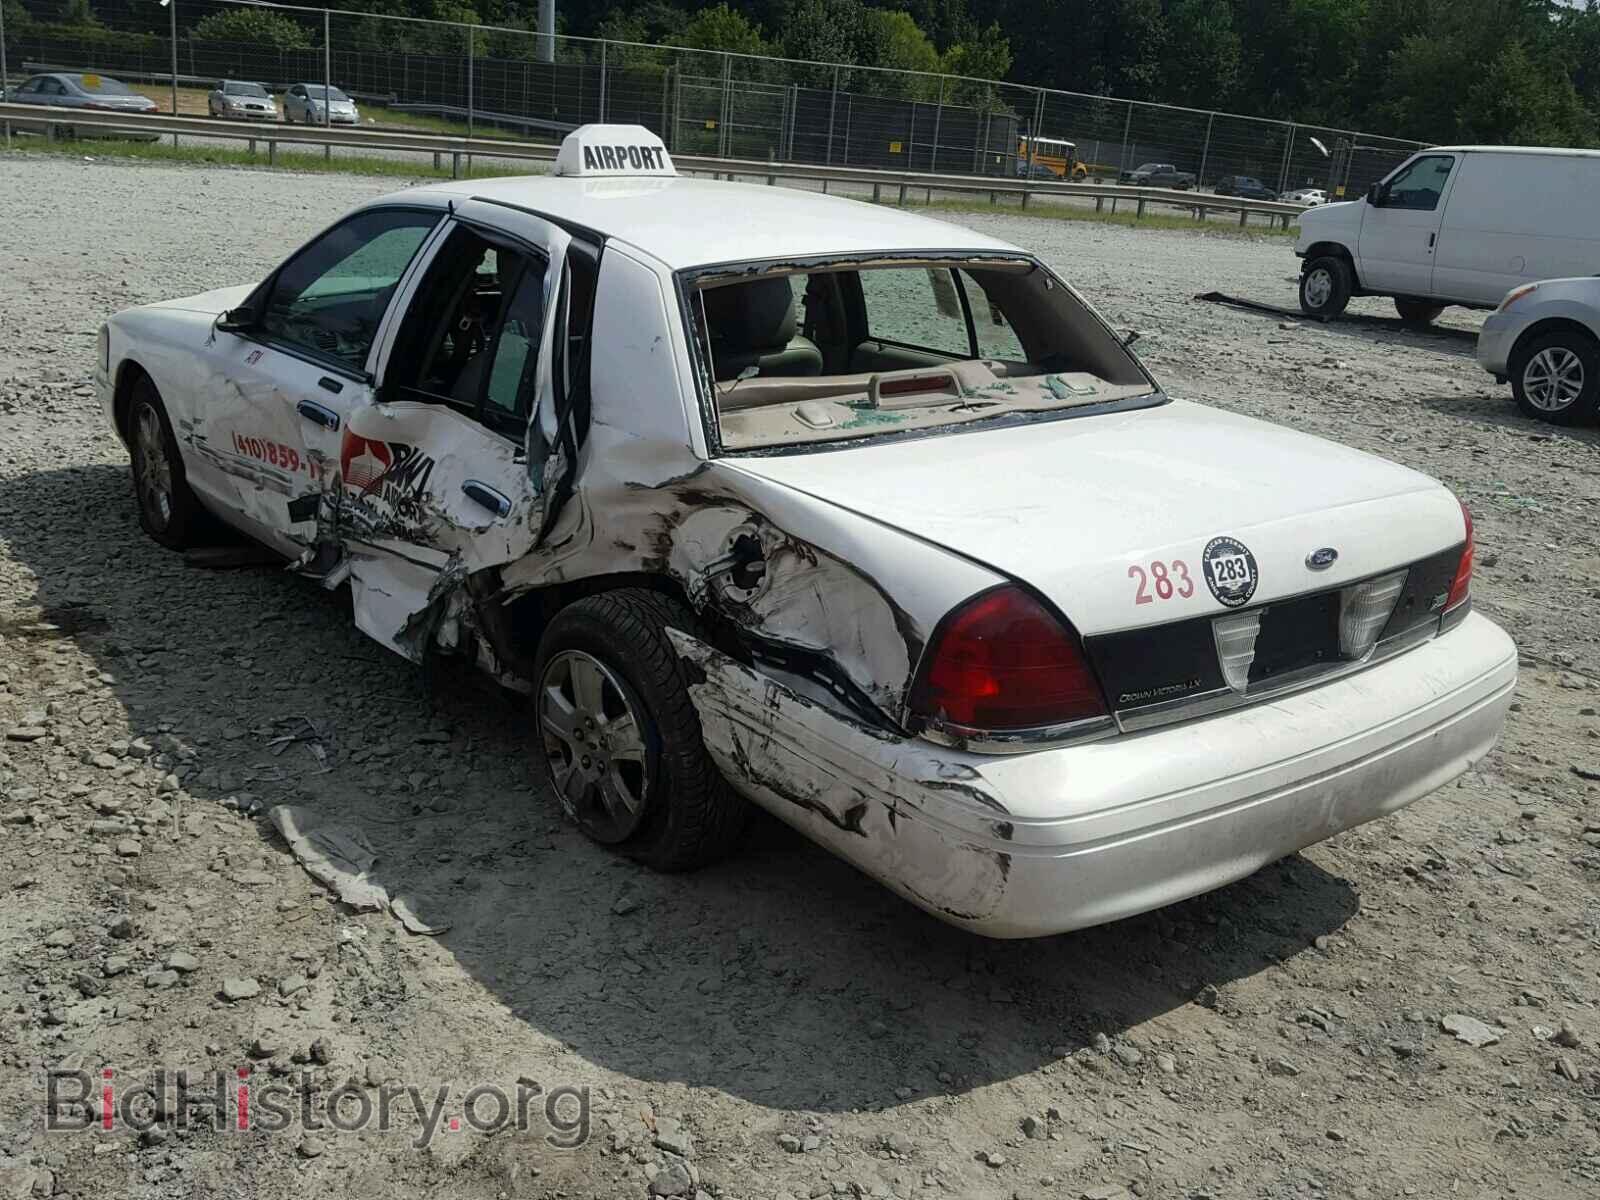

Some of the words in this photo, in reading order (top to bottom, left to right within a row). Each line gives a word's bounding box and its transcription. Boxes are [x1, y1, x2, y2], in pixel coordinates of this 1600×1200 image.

[583, 145, 665, 170] AIRPORT
[1215, 557, 1247, 582] 283
[1128, 560, 1194, 605] 283
